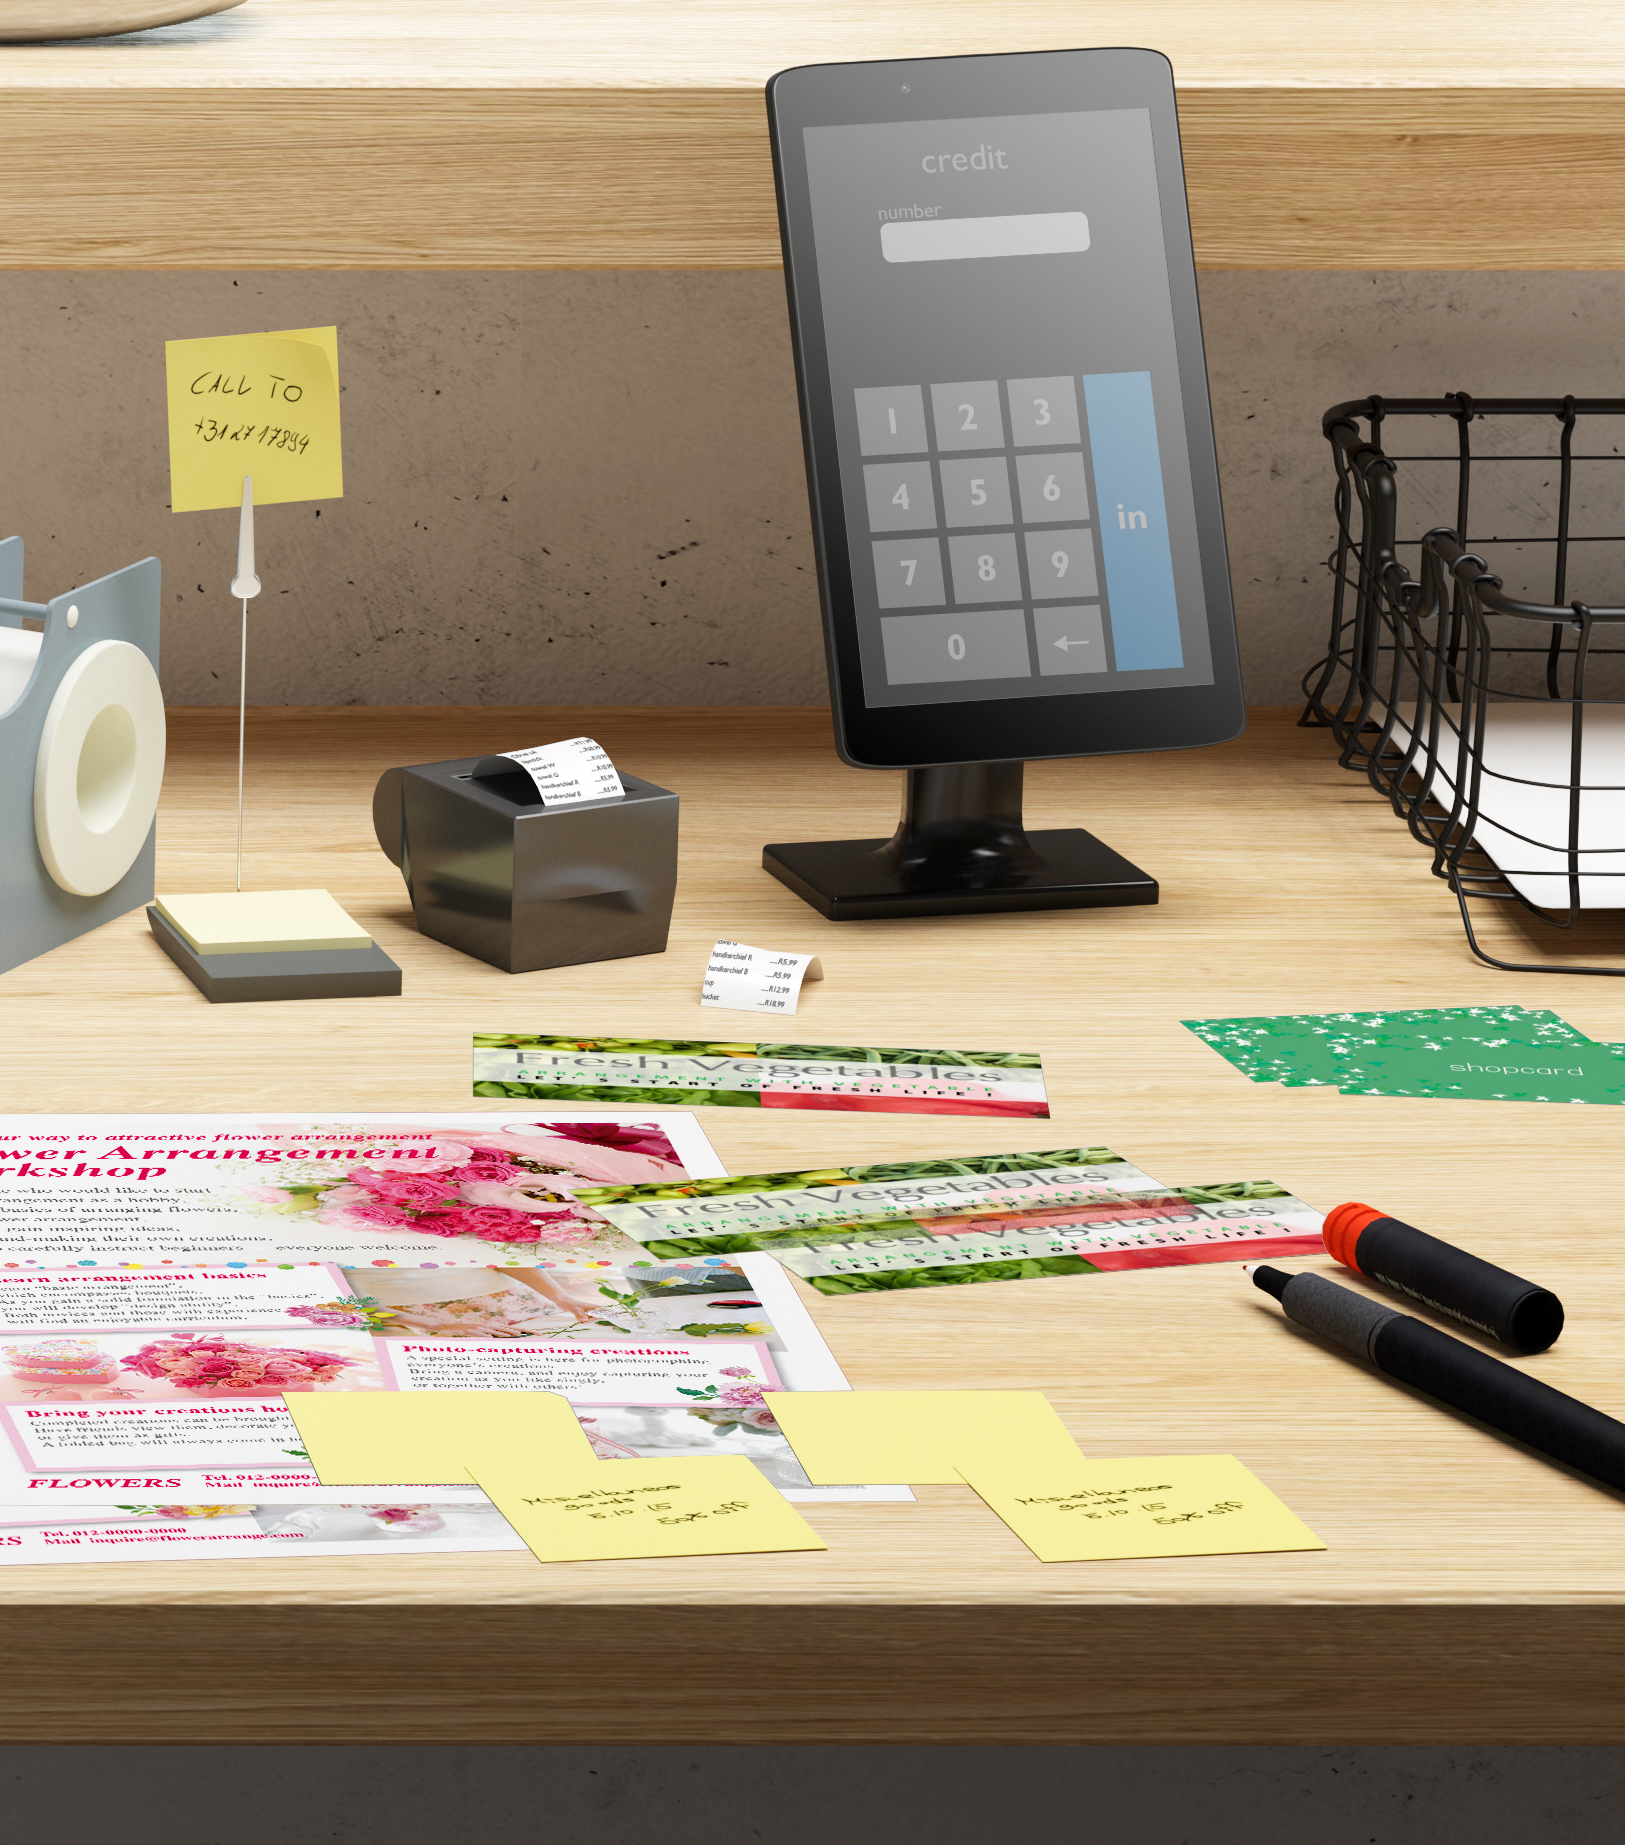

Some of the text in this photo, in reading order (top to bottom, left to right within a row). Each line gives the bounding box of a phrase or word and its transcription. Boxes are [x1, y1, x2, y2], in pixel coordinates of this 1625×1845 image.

[921, 144, 1009, 175] credit
[877, 202, 942, 222] number
[190, 371, 303, 403] CALL TO
[887, 398, 1052, 435] 1 2 3
[891, 474, 1061, 512] 4 5 6
[1116, 501, 1148, 532] in
[899, 549, 1070, 587] 7 8 9
[946, 633, 966, 662] 0
[704, 979, 715, 988] cup
[516, 1052, 1003, 1083] Fresh Vegetables
[518, 1069, 726, 1082] ARRANGEMENT
[834, 1080, 994, 1092] VEGETABLE
[1449, 1062, 1584, 1077] shopcard
[28, 1135, 71, 1144] way
[77, 1134, 99, 1142] to
[105, 1133, 209, 1142] attractive
[212, 1133, 286, 1143] flower
[290, 1132, 434, 1143] arrangement
[96, 1145, 440, 1164] Arrangement
[635, 1166, 1111, 1223] Fresh Vegetables
[969, 1203, 1279, 1239] Vegetables
[27, 1478, 183, 1489] FLOWERS
